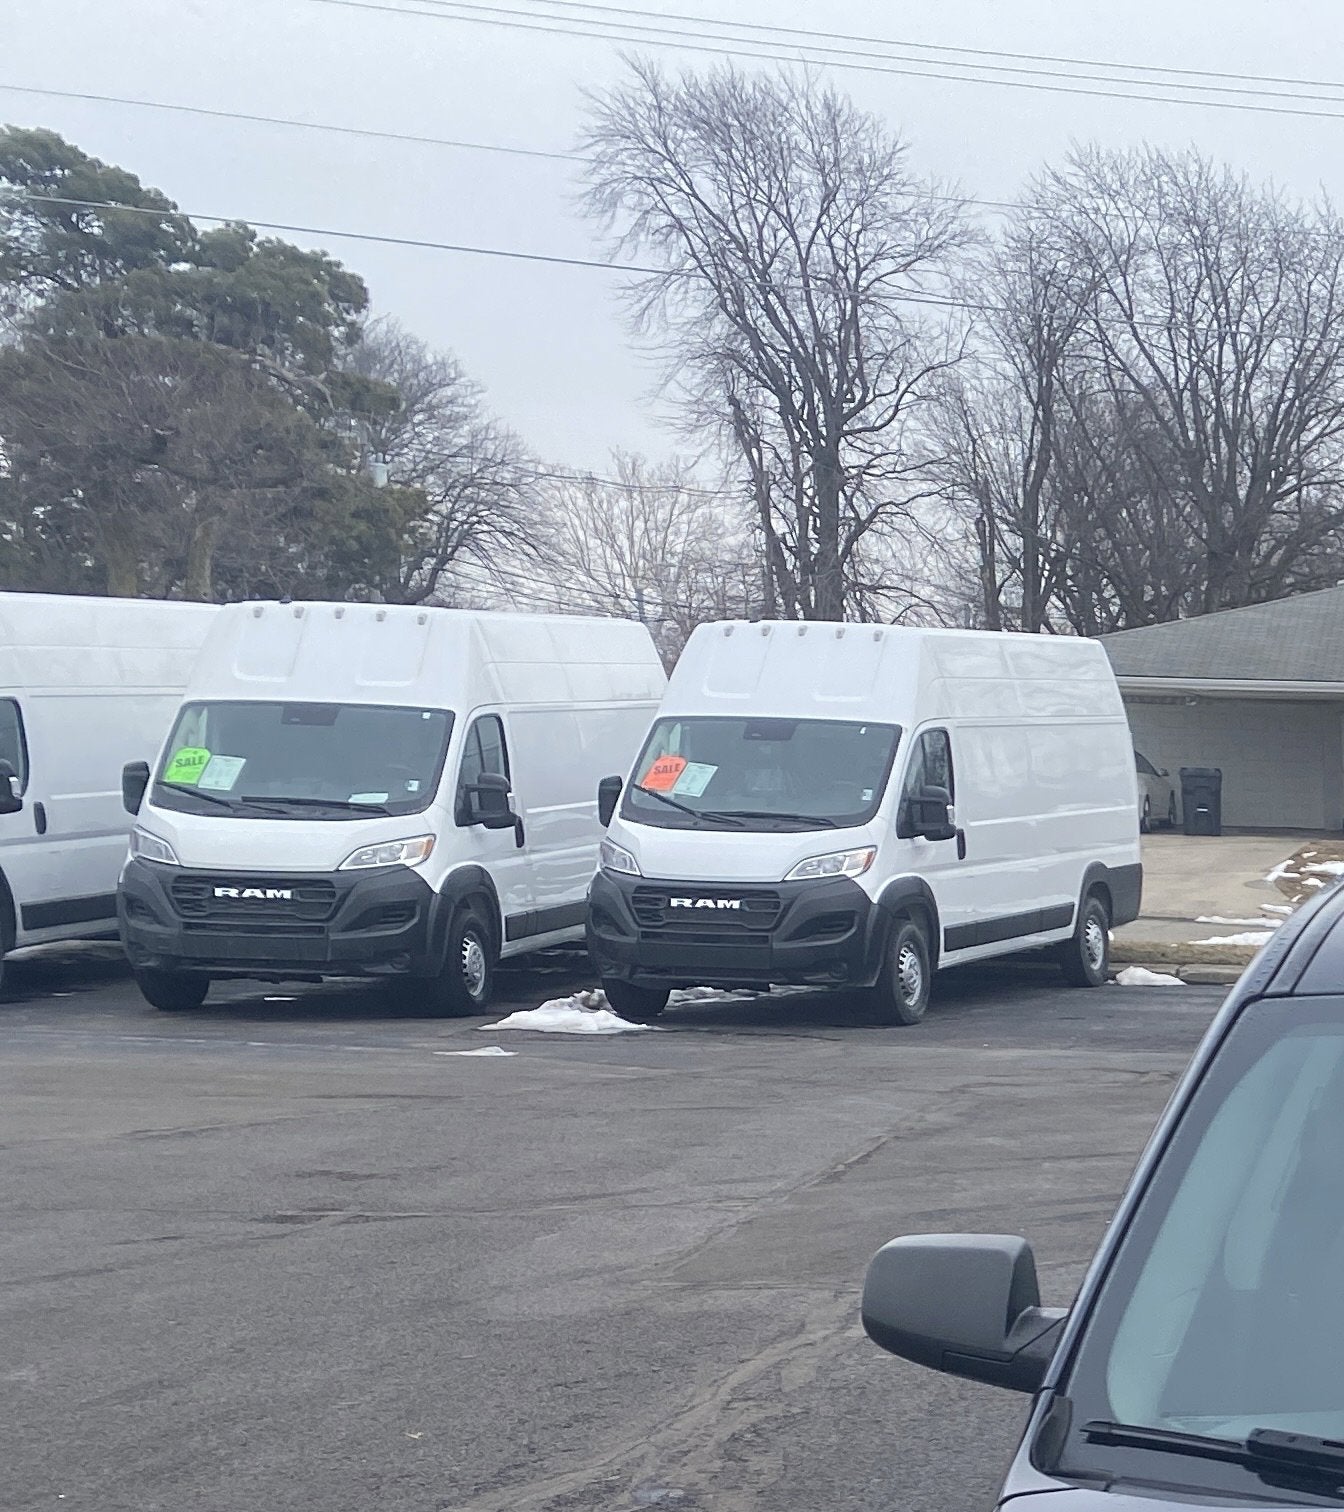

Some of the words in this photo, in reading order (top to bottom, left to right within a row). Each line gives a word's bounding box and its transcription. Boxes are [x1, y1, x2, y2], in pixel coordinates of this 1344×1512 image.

[175, 755, 205, 769] SALE
[653, 763, 681, 775] SALE
[214, 887, 292, 899] RAM
[670, 897, 741, 909] RAM
